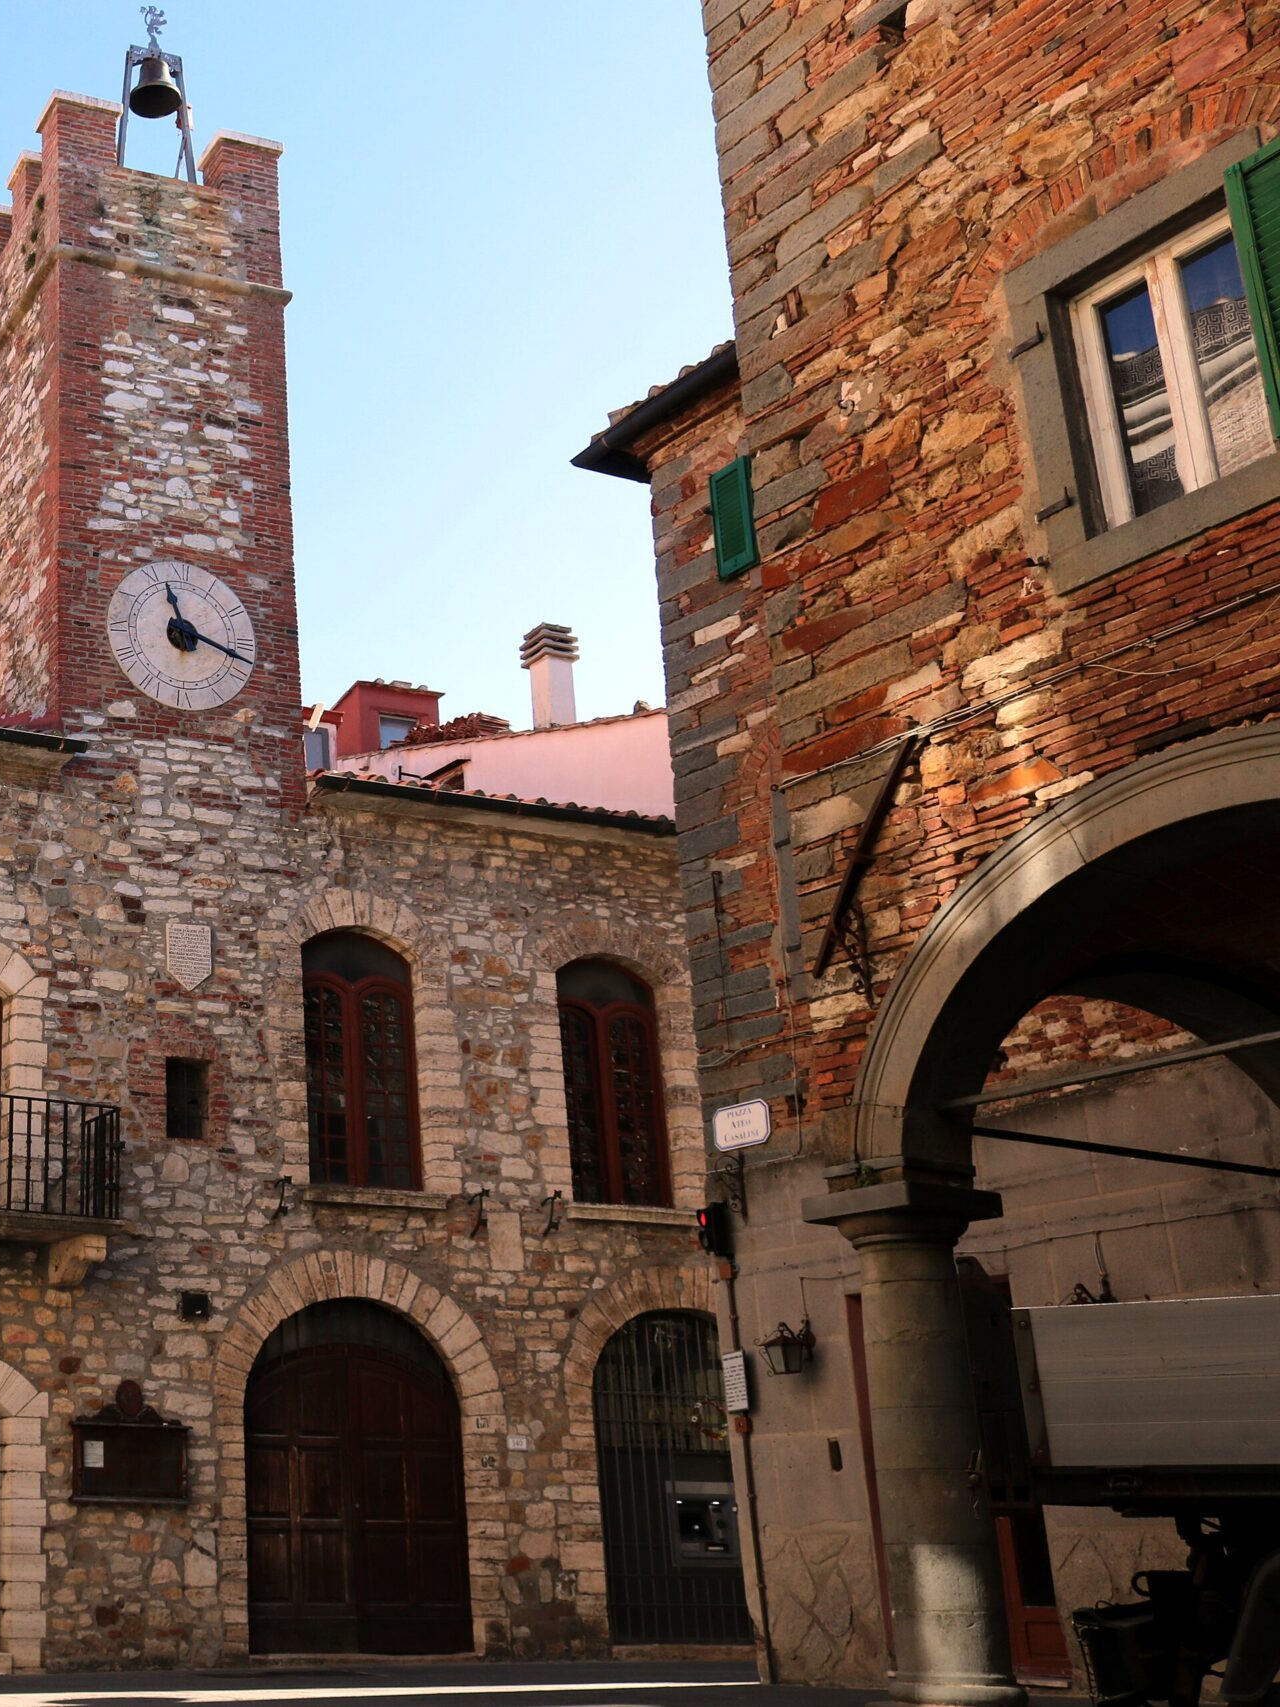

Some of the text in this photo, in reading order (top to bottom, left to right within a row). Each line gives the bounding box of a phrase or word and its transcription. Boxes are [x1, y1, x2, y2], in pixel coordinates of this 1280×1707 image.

[236, 637, 255, 652] III
[727, 1107, 752, 1119] PIAZZA
[724, 1129, 759, 1142] CASALINI
